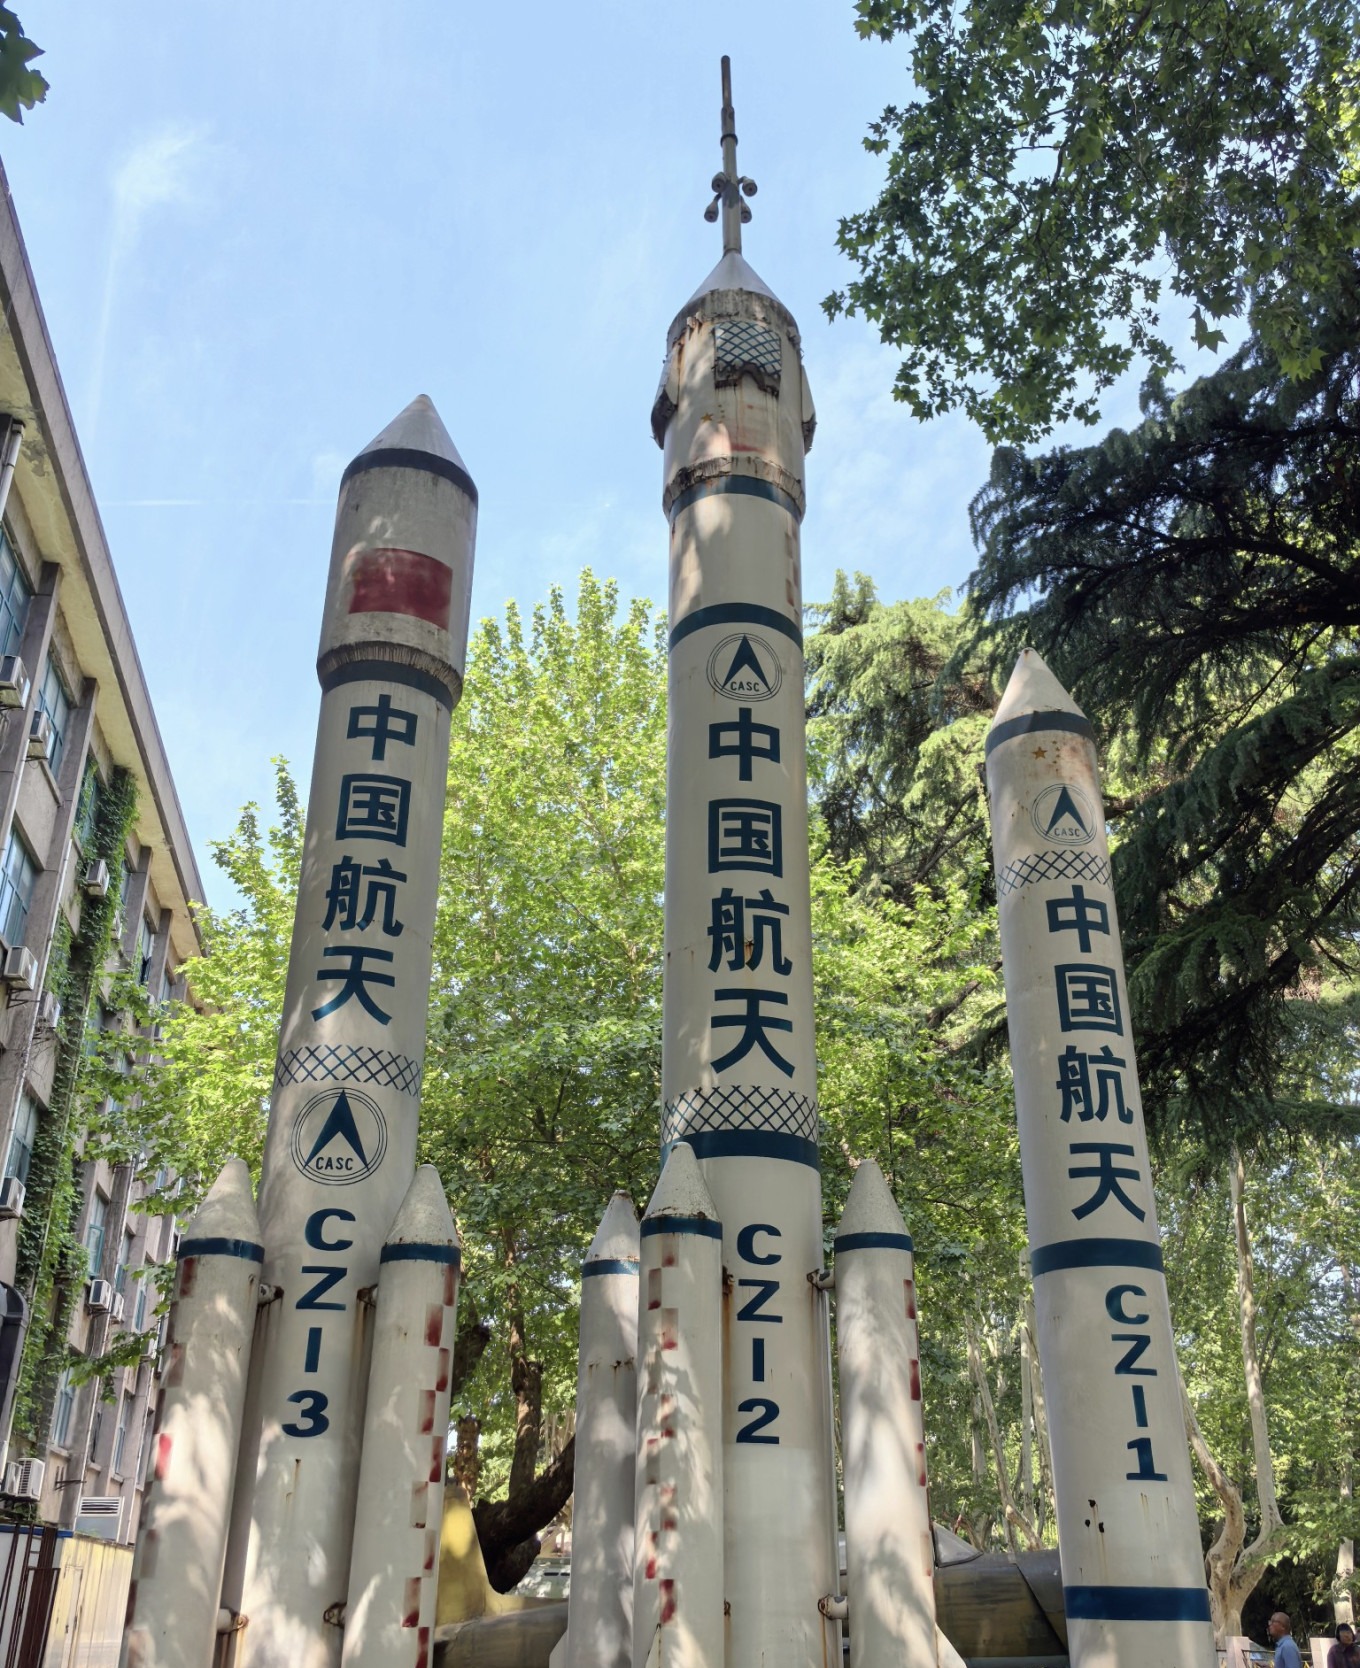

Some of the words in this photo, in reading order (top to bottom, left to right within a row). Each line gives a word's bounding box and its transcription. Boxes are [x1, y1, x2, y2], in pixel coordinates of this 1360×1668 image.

[730, 681, 759, 692] CASC
[311, 693, 418, 1026] 中国航天
[708, 707, 795, 1078] 中国航天
[1054, 828, 1080, 837] CASC
[1046, 885, 1145, 1222] 中国航天
[316, 1157, 353, 1170] CASC
